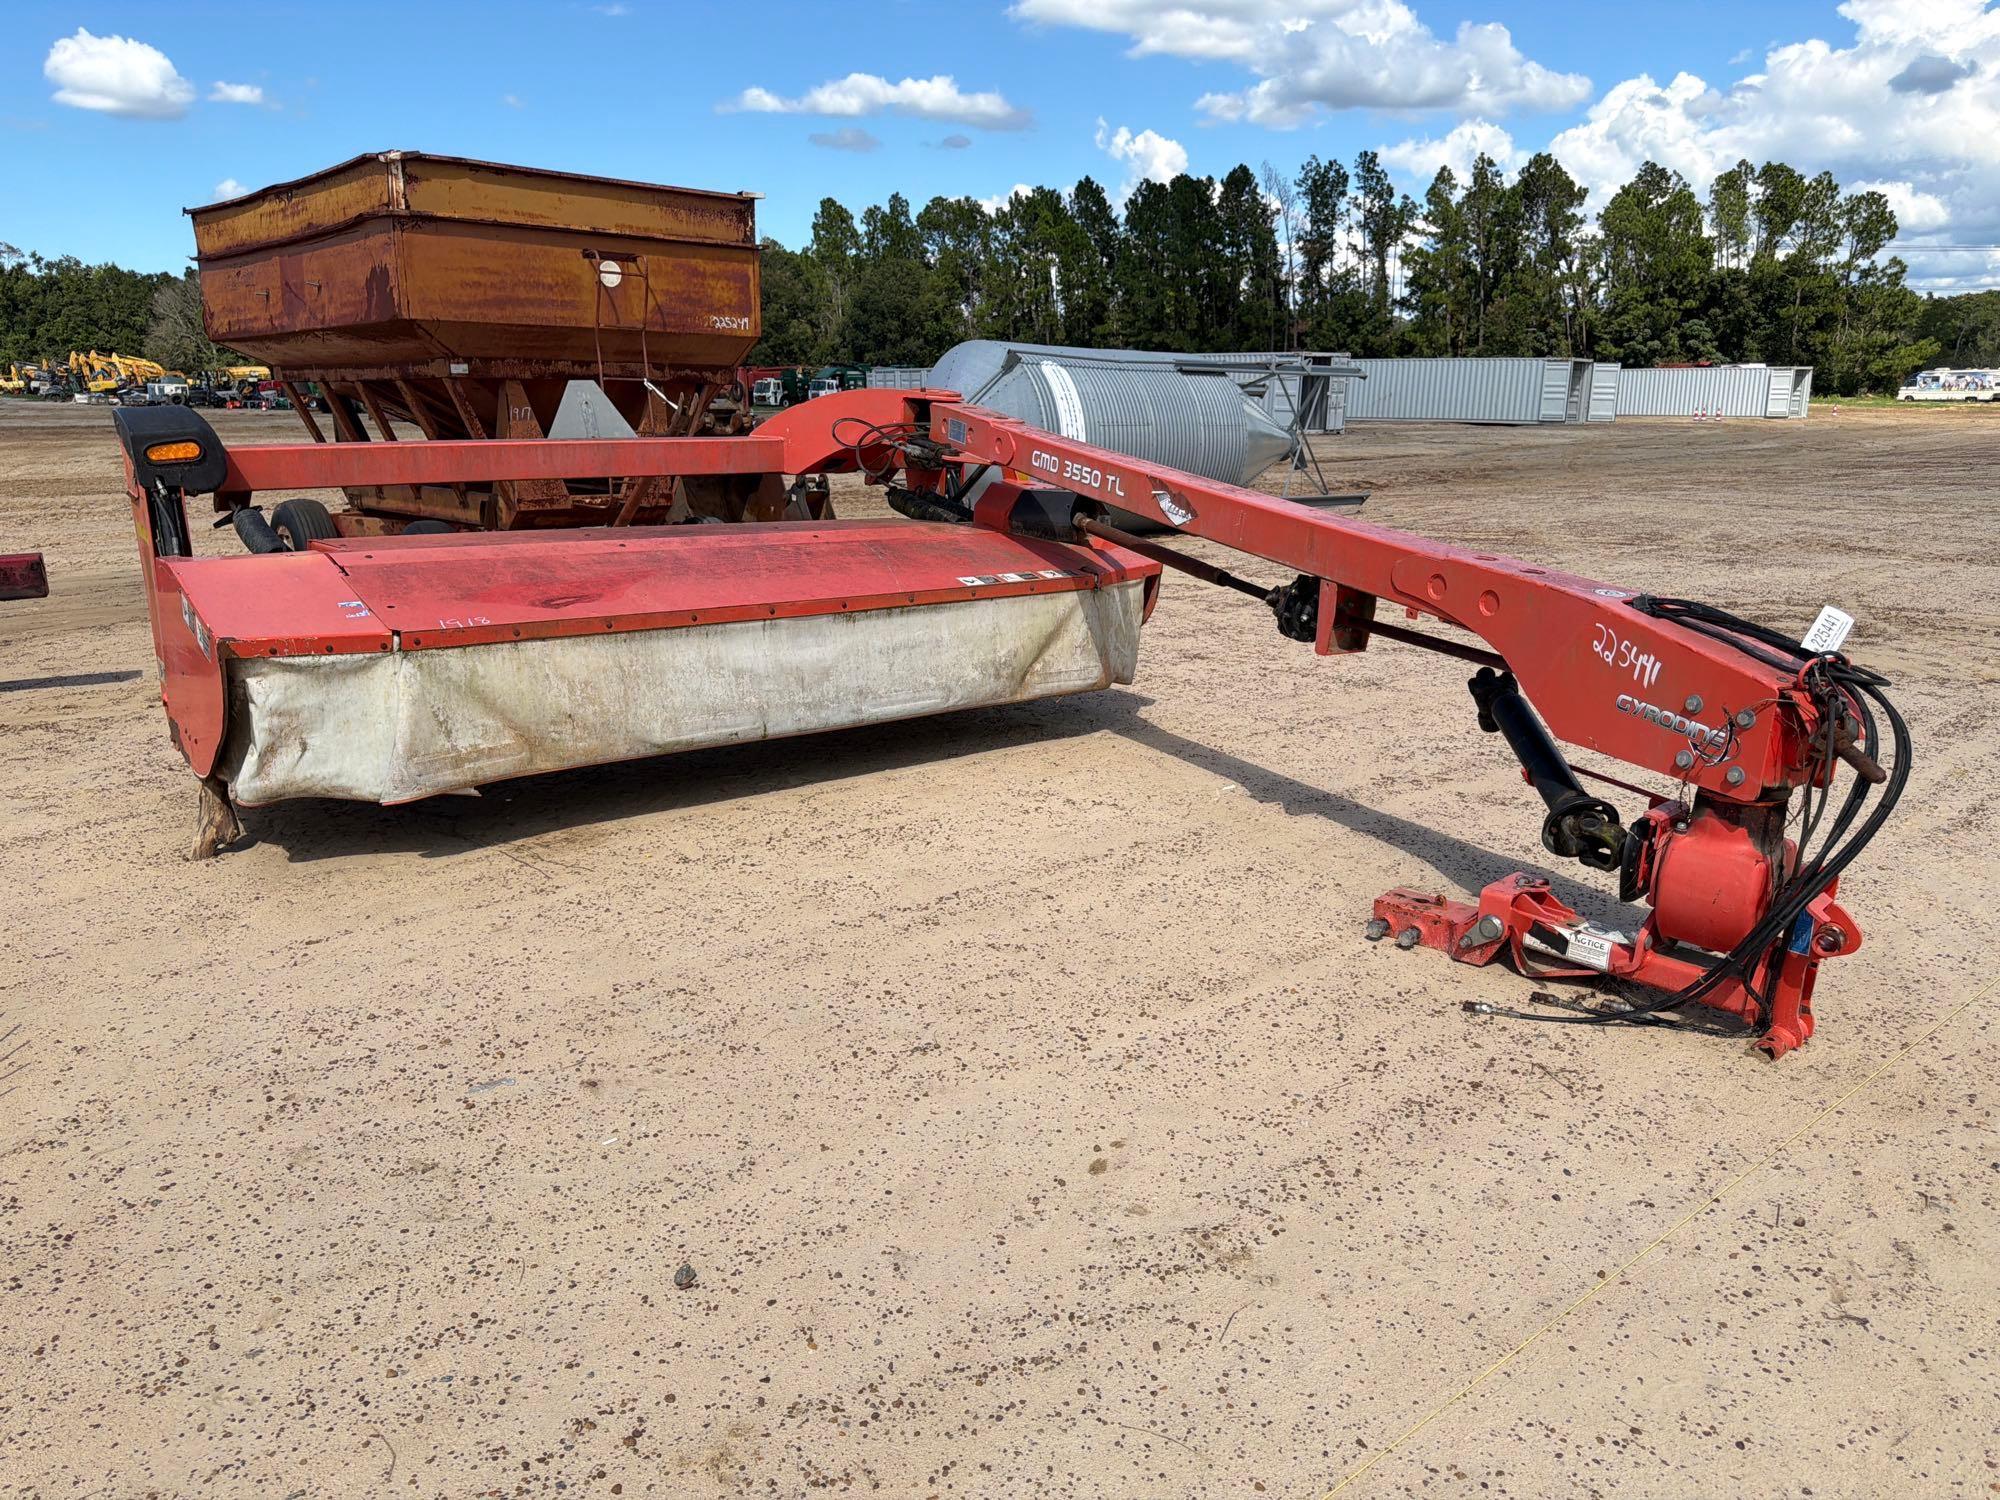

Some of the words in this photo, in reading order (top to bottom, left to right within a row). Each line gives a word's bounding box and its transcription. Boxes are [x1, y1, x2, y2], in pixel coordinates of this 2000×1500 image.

[1031, 450, 1059, 474] GMD
[1063, 460, 1101, 489] 3550
[1106, 475, 1125, 497] TL
[439, 616, 490, 629] 1918
[1592, 623, 1662, 688] 225441
[1615, 694, 1728, 750] GYRODINE
[1574, 935, 1606, 950] NOTICE
